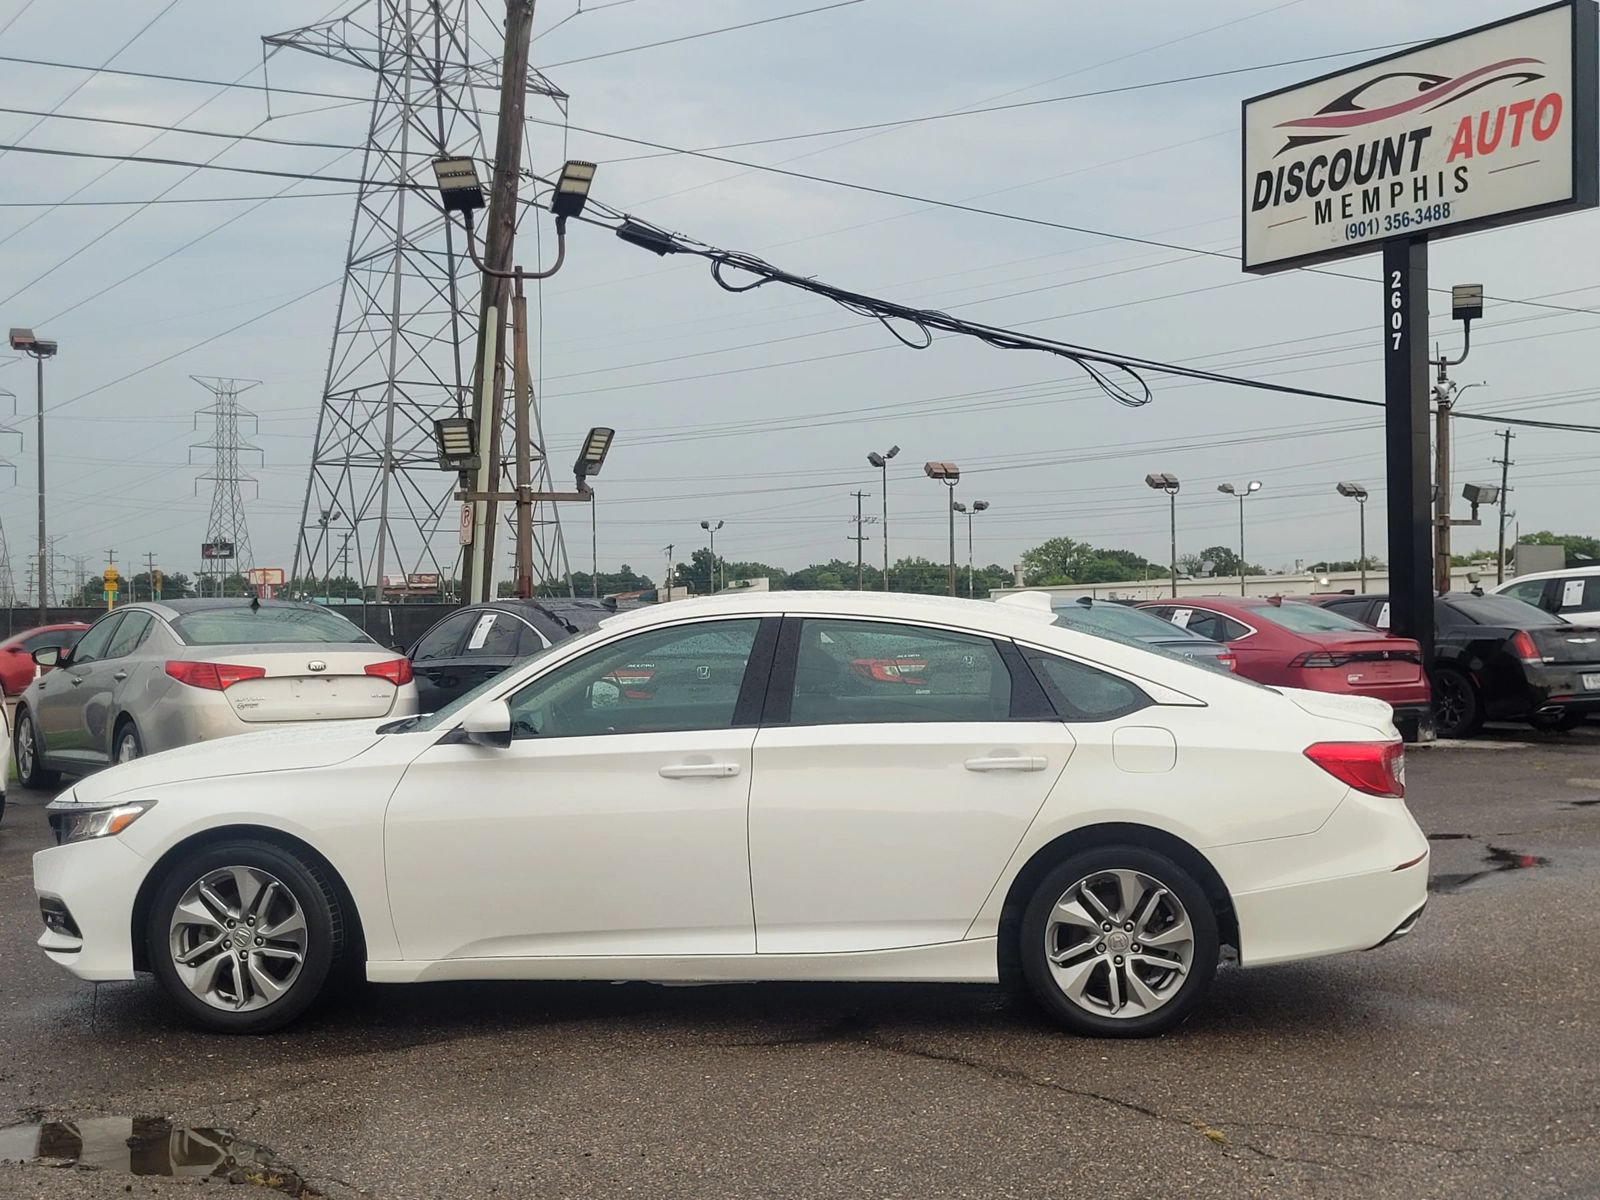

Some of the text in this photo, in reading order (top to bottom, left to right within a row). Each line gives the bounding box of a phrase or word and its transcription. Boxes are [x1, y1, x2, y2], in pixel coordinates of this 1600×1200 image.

[1251, 92, 1563, 212] DISCOUNT AUTO
[1314, 166, 1469, 225] MEMPHIS
[1344, 202, 1451, 241] (901) 356-3488
[1391, 270, 1402, 351] 2607
